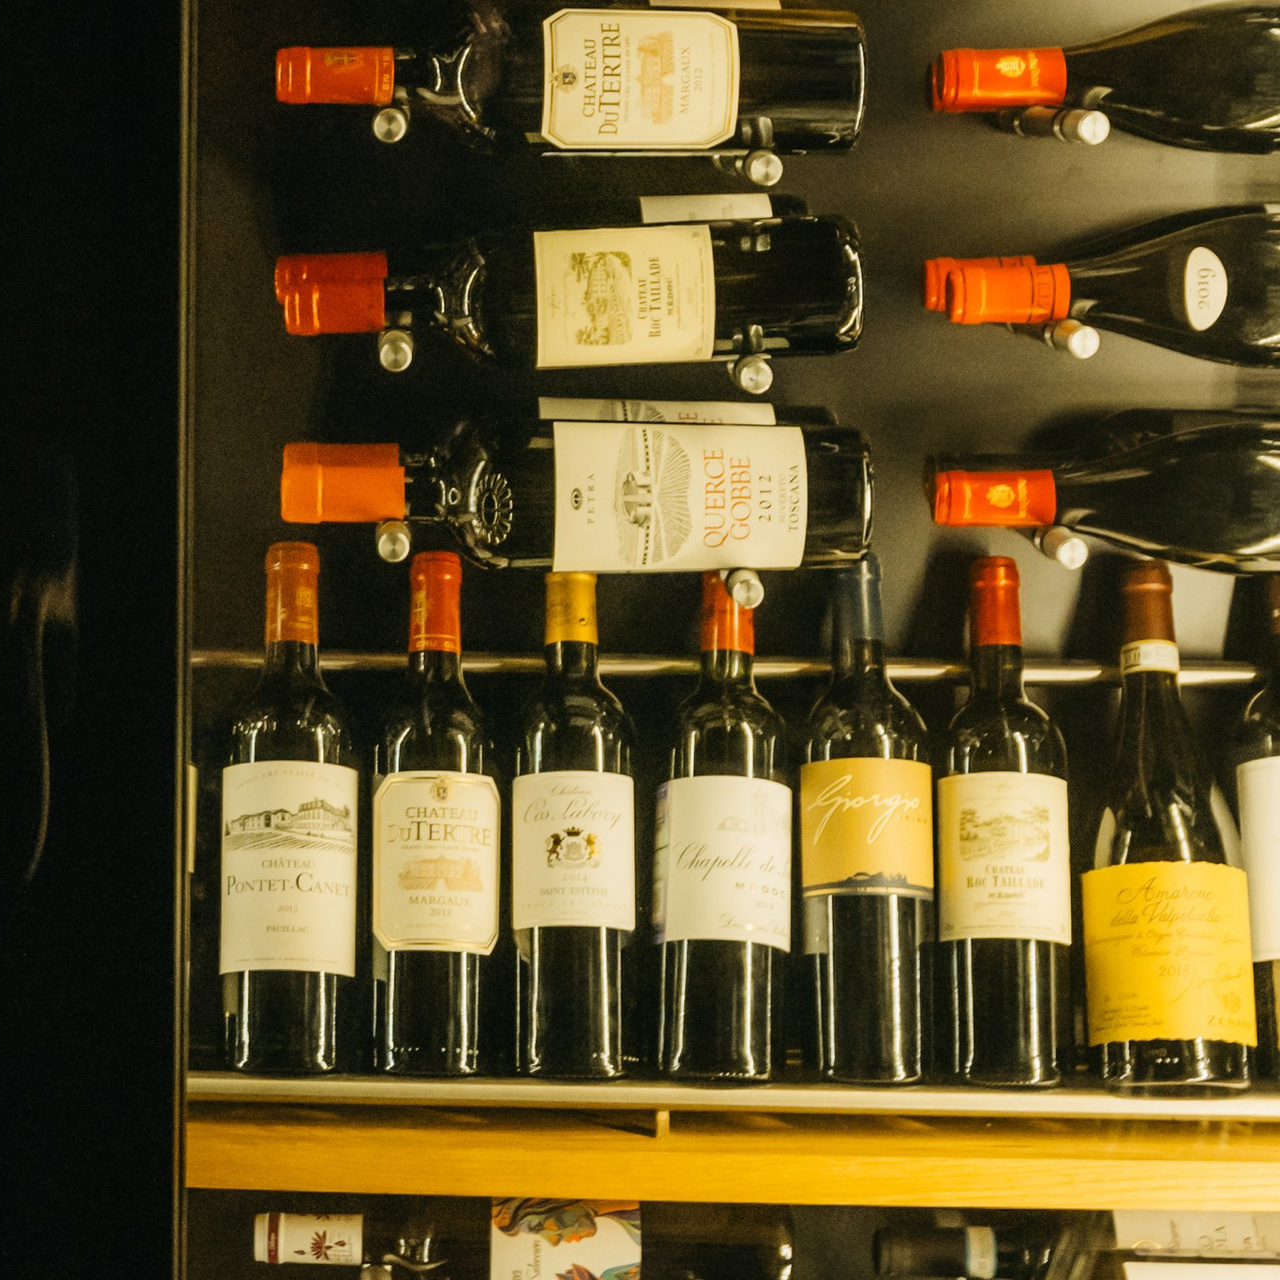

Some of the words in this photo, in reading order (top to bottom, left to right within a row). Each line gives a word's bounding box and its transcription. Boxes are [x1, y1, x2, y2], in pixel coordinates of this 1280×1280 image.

[582, 39, 597, 118] CHATEAU
[680, 46, 691, 115] MARGAUX
[693, 67, 703, 92] 2012
[648, 256, 662, 315] TAILLADE
[1197, 267, 1217, 310] 2019
[648, 317, 662, 338] ROC
[586, 473, 596, 525] PETRA
[703, 448, 729, 549] QUERCE
[730, 456, 752, 541] GOBBE
[758, 474, 772, 522] 2012
[788, 464, 799, 533] TOSCANA
[405, 807, 479, 822] CHATEAU
[806, 773, 921, 847] Giorgio
[261, 857, 315, 869] CHÂTEAU
[673, 841, 754, 881] Chapelle
[226, 871, 351, 897] PONTET-CANET
[408, 895, 472, 907] MARGAUX
[966, 876, 988, 889] ROC
[1116, 876, 1215, 905] Amarone
[429, 907, 453, 917] 2012
